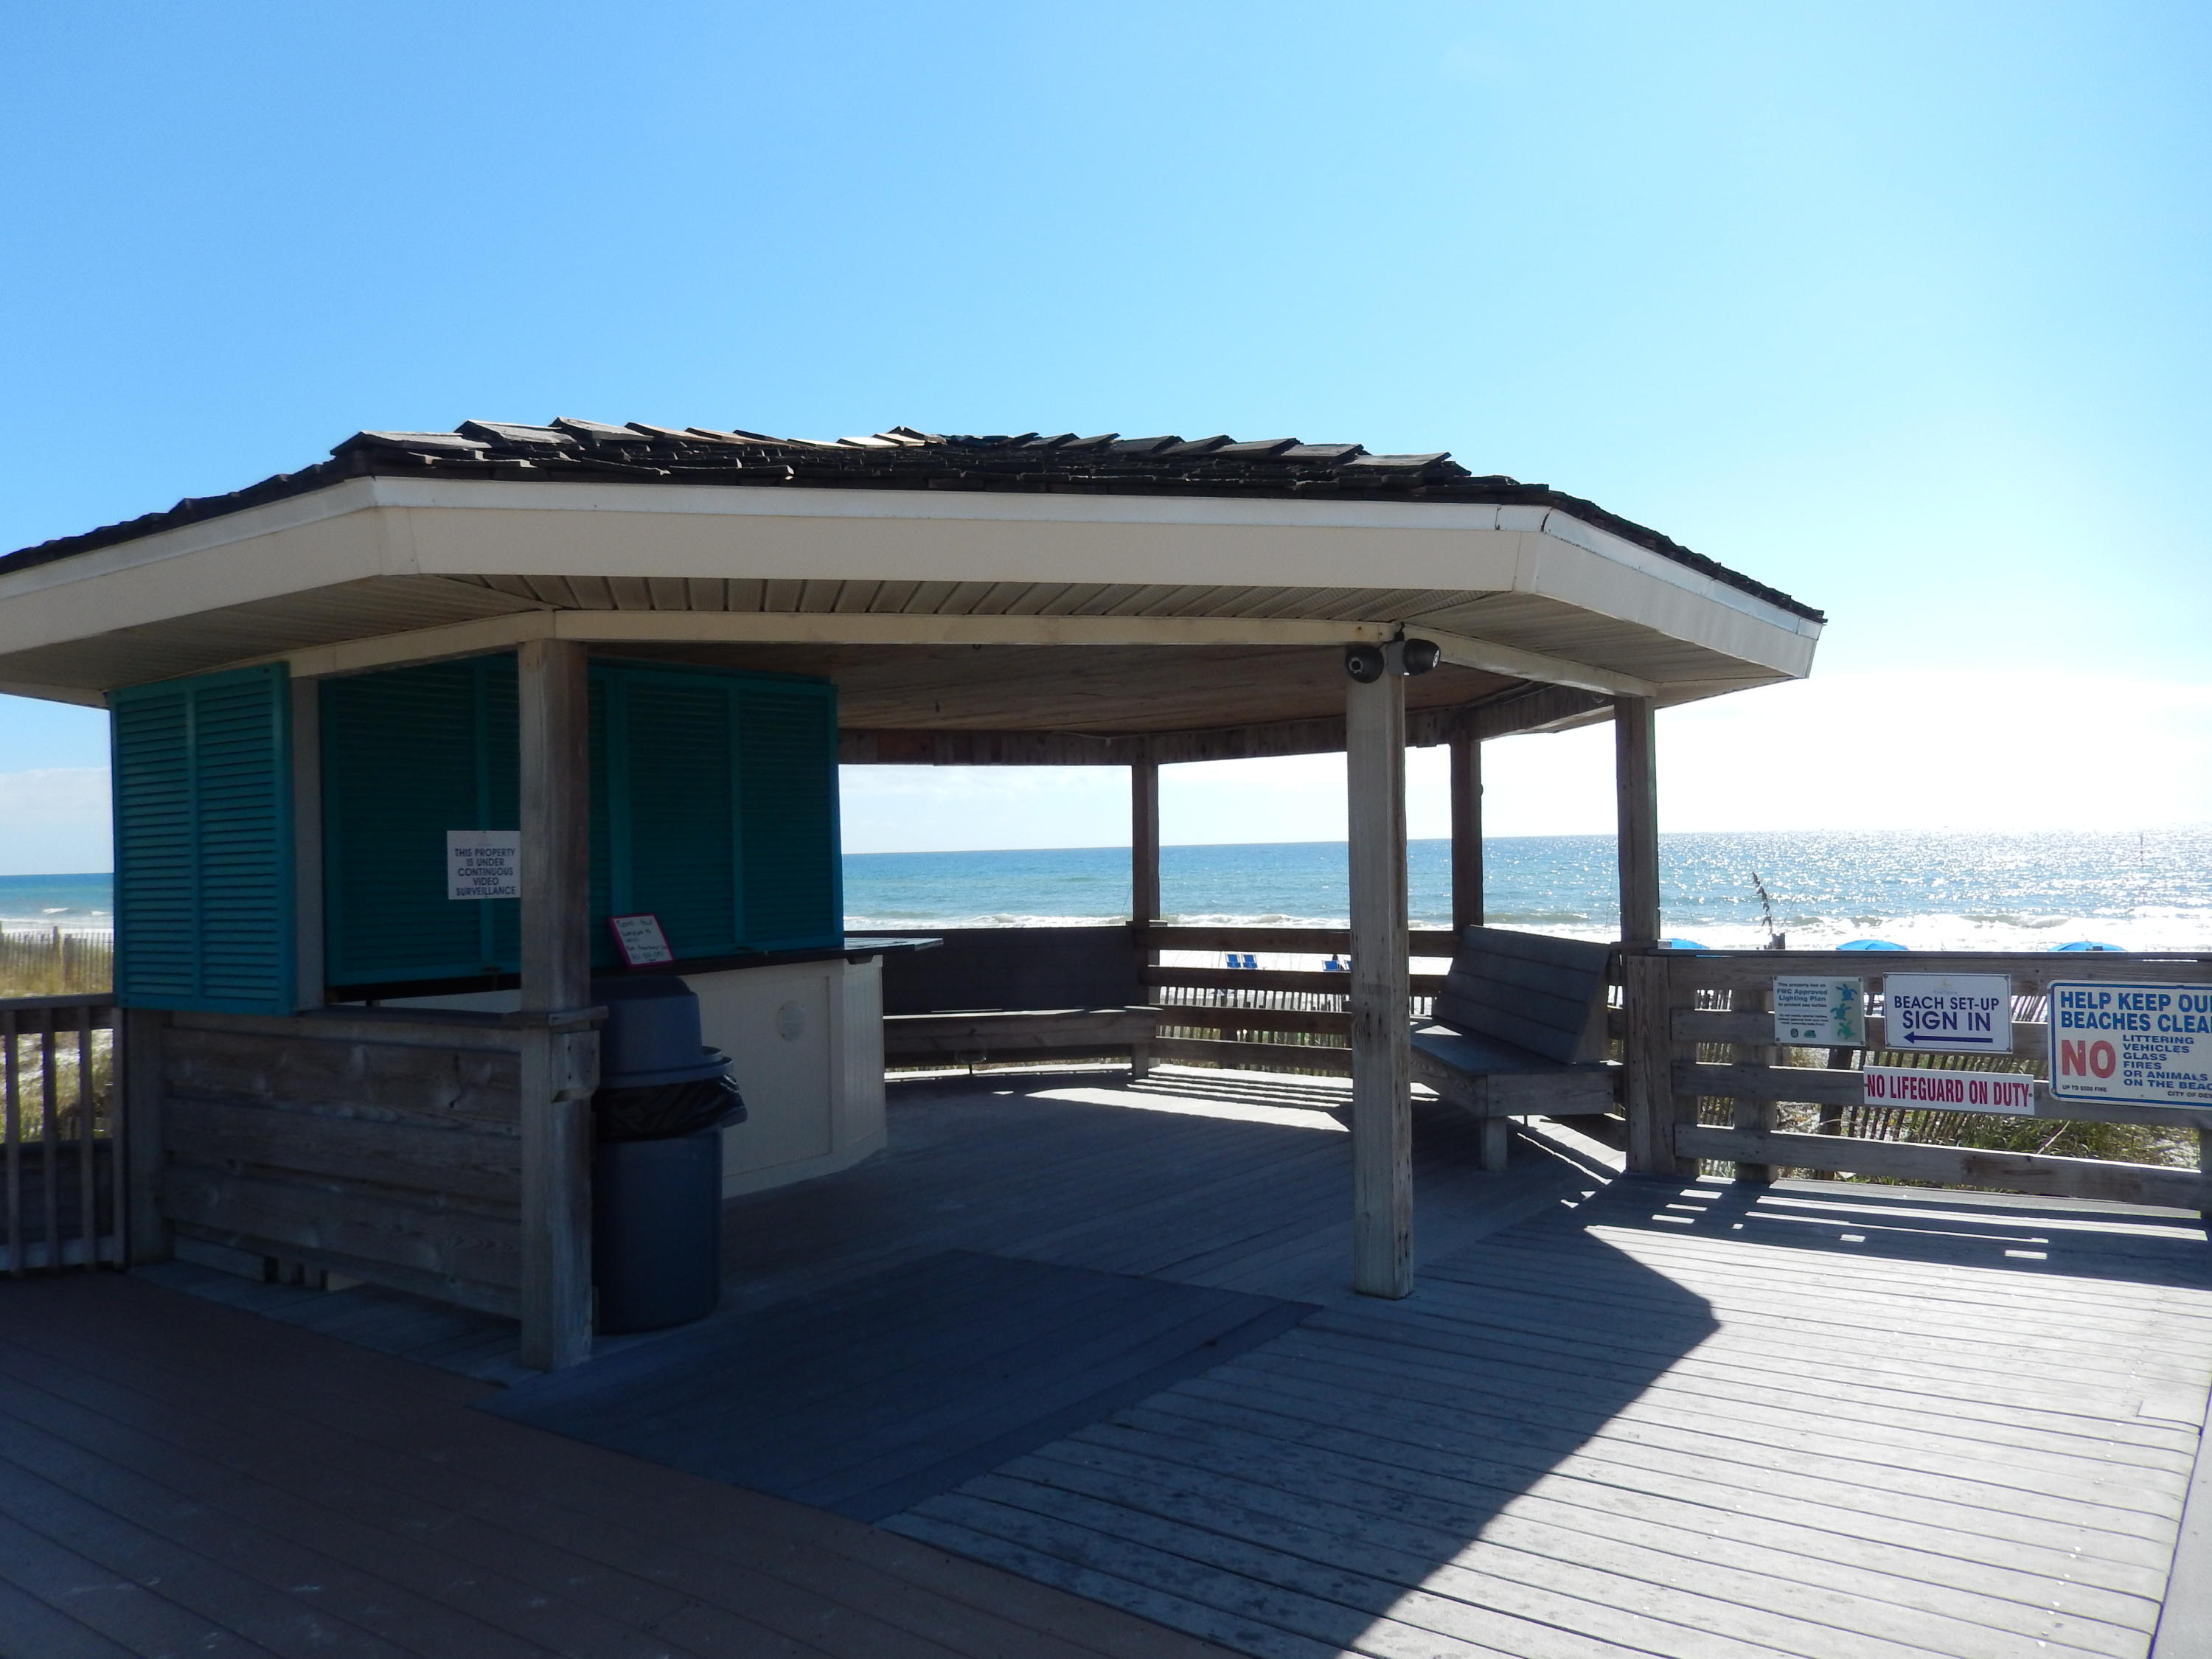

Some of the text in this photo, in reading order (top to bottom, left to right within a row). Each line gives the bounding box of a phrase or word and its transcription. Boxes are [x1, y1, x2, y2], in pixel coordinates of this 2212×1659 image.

[454, 848, 516, 857] THIS PROPERTY
[467, 858, 504, 866] IS UNDER
[458, 867, 513, 877] CONTINUOUS
[473, 877, 499, 886] VIDEO
[456, 886, 516, 896] SURVEILLANCE
[1894, 995, 2000, 1011] BEACH SET-UP
[2061, 991, 2212, 1014] HELP KEEP OU
[1902, 1010, 1991, 1032] SIGN IN
[2061, 1011, 2212, 1034] BEACHES CLEA
[2123, 1034, 2194, 1045] LITTERING
[2123, 1043, 2189, 1054] VEHICLES
[2061, 1040, 2116, 1079] NO
[2123, 1052, 2167, 1062] GLASS
[2124, 1061, 2162, 1070] FIRES
[2124, 1070, 2208, 1082] OR ANIMALS
[2124, 1079, 2143, 1087] ON
[2147, 1079, 2174, 1089] THE
[1867, 1074, 2029, 1107] NO LIFEGUARD ON DUTY
